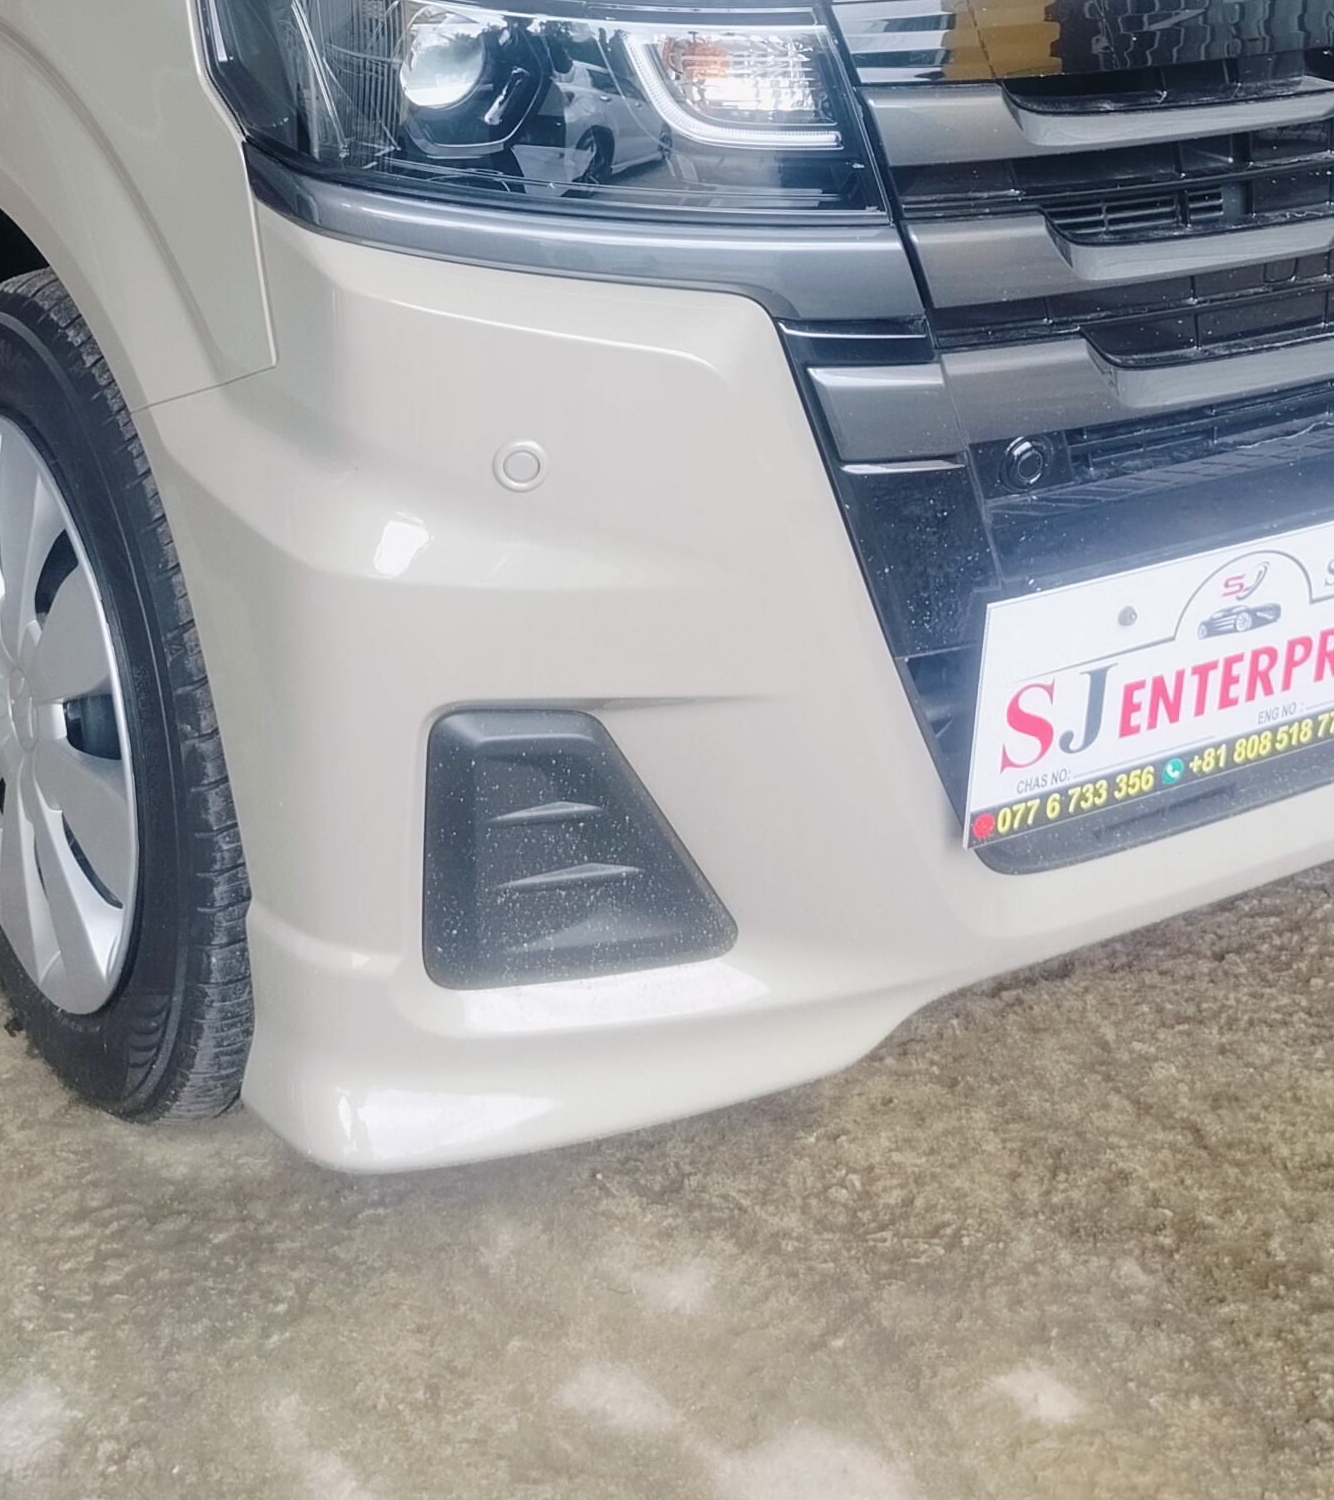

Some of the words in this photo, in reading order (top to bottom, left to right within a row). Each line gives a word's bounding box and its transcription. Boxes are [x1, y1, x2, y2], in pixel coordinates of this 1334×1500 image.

[1257, 706, 1279, 725] ENG
[1189, 743, 1227, 774] +81
[1233, 731, 1273, 763] 808
[1274, 718, 1314, 751] 518
[996, 798, 1041, 834] 077
[1046, 793, 1061, 820] 6
[1068, 779, 1109, 813] 733
[1113, 765, 1155, 799] 356
[1016, 772, 1048, 795] CHAS
